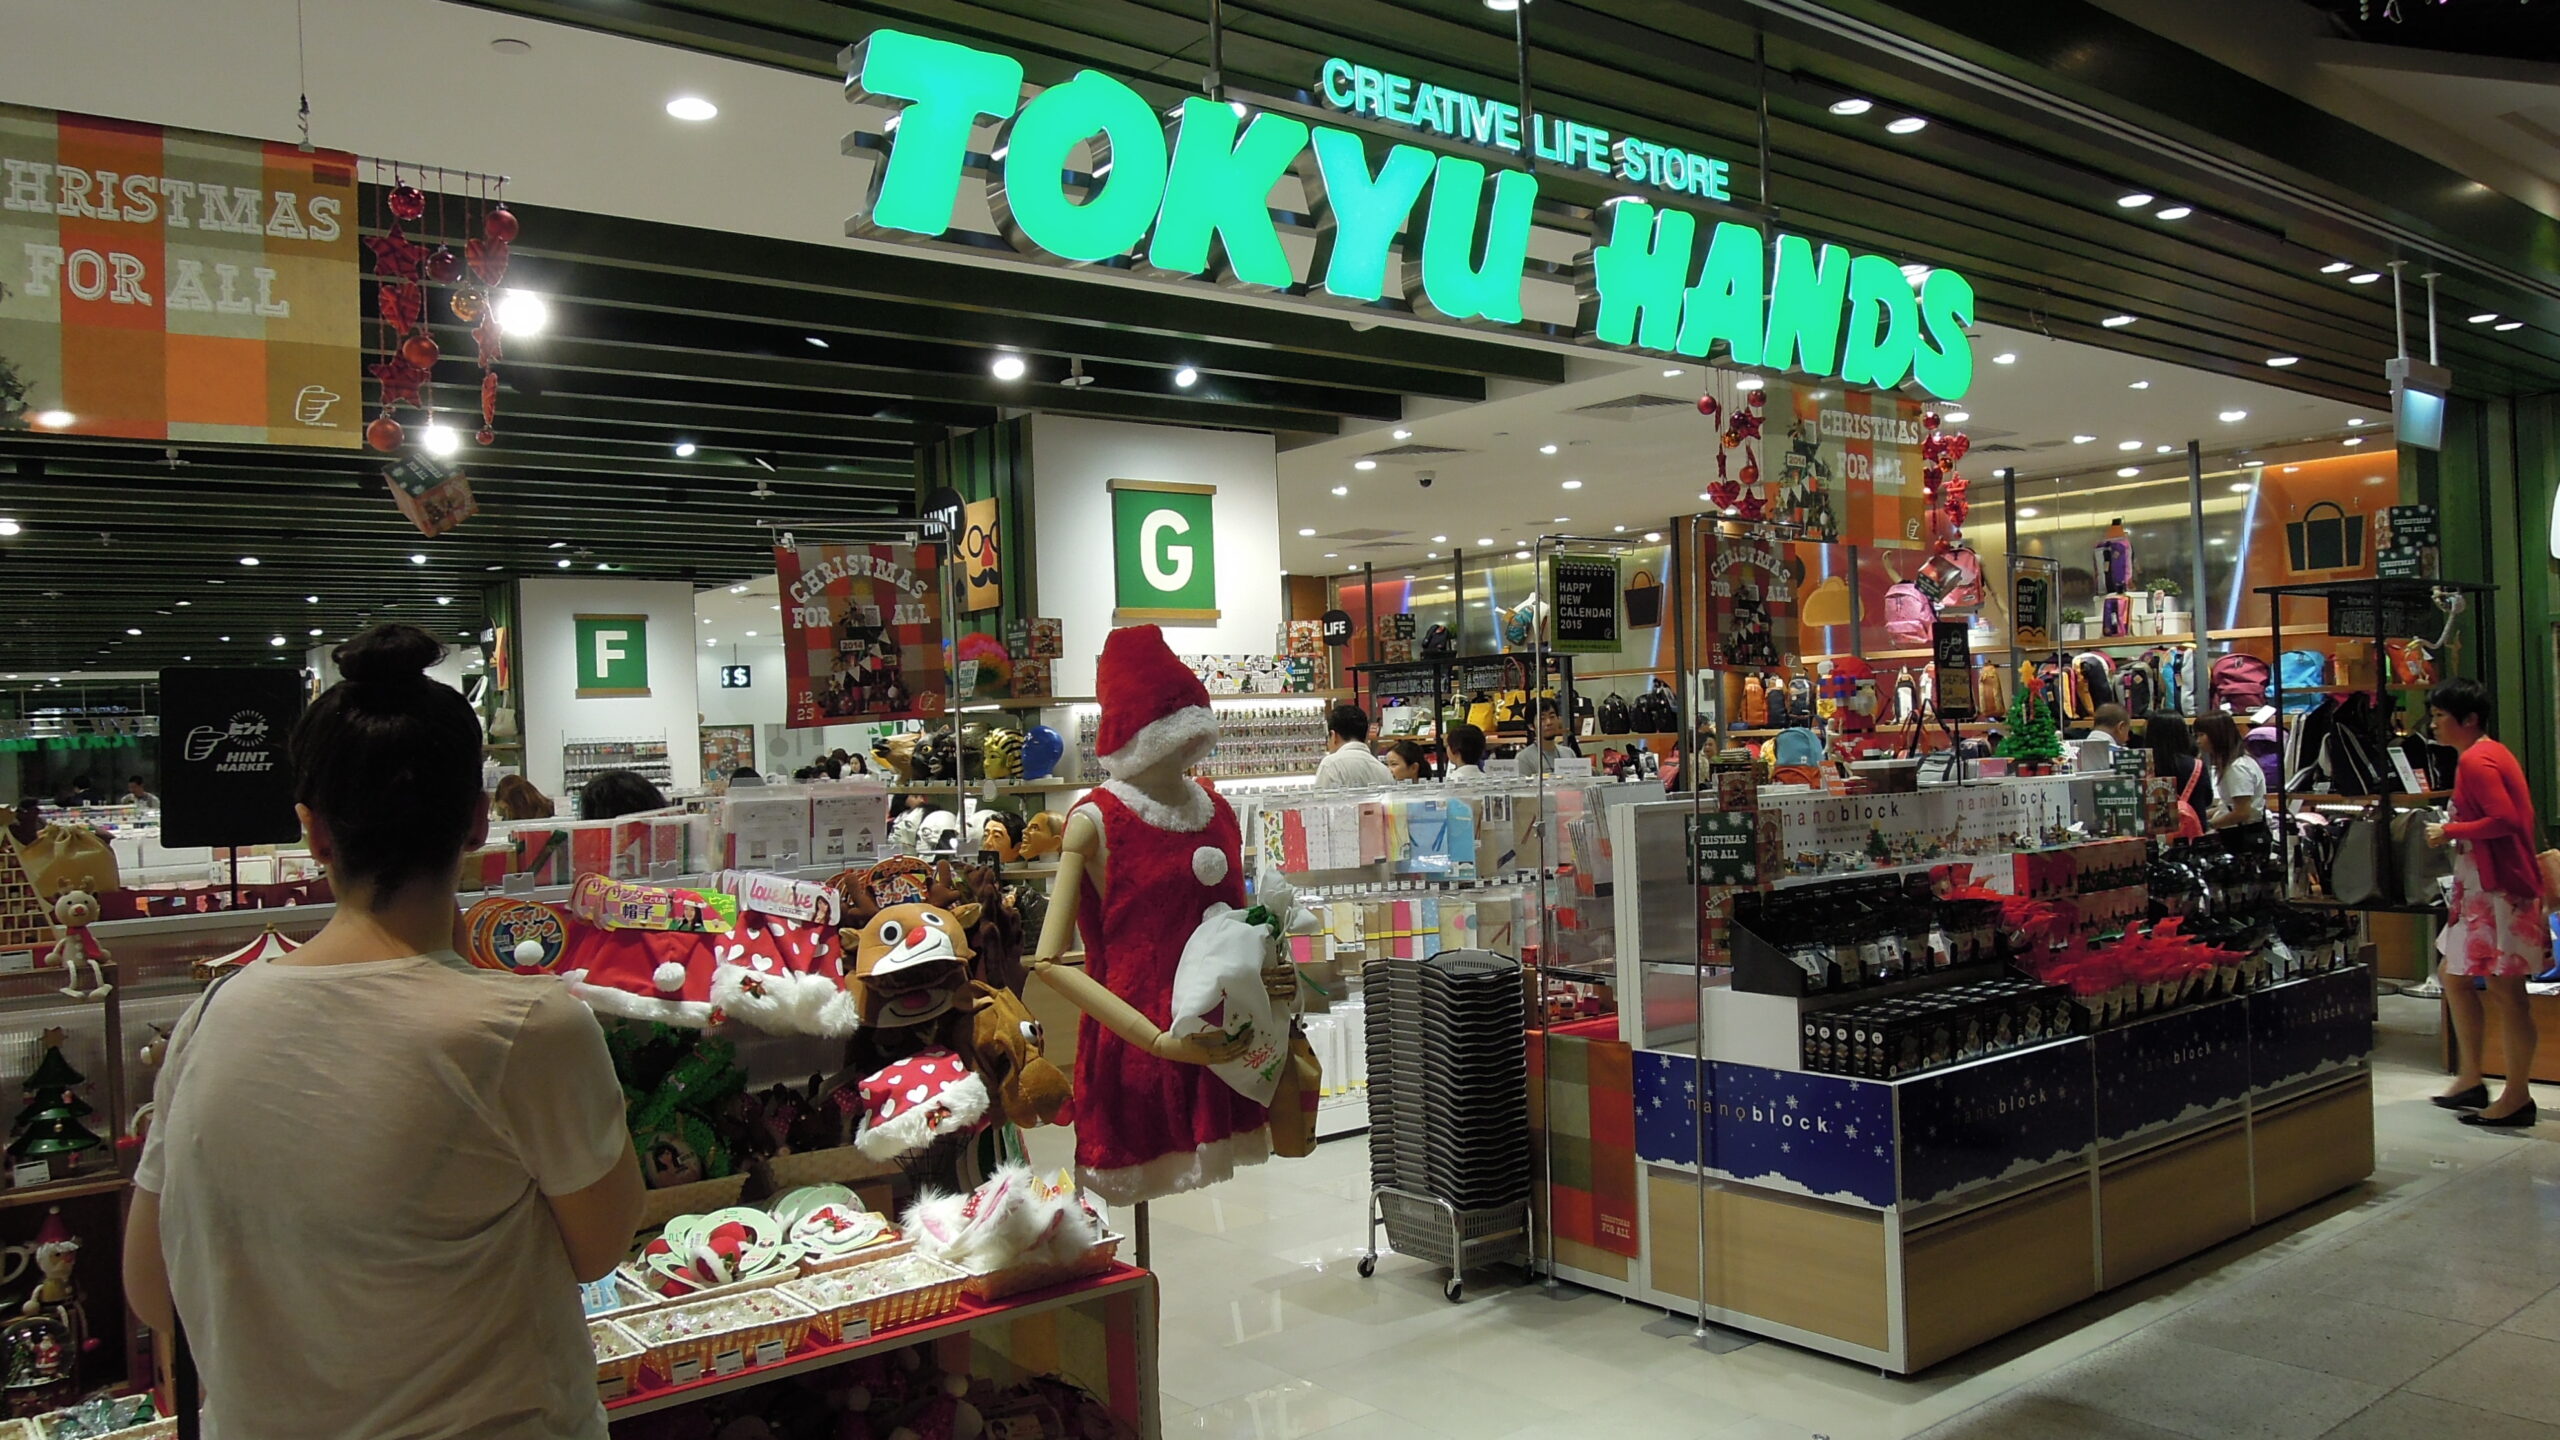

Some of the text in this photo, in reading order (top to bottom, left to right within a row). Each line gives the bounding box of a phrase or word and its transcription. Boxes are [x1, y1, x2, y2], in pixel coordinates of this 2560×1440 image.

[1322, 58, 1729, 201] CREATIVE LIFE STORE
[861, 29, 1974, 399] TOKYU HANDS
[24, 244, 290, 318] FOR ALL
[1820, 409, 1919, 445] CHRISTMAS
[1837, 451, 1906, 484] FOR ALL
[924, 505, 958, 536] HINT
[1140, 509, 1193, 592] G
[1710, 546, 1791, 583] CHRISTMAS
[789, 554, 928, 604] CHRISTMAS
[1559, 583, 1592, 594] HAPPY
[1559, 595, 1581, 605] NEW
[1711, 581, 1792, 602] FOR ALL
[792, 604, 931, 628] FOR ALL
[1560, 607, 1612, 619] CALENDAR
[1324, 621, 1346, 635] LIFE
[1560, 620, 1583, 630] 2015
[595, 630, 627, 678] F
[734, 667, 747, 686] $
[798, 691, 813, 704] 12
[797, 708, 815, 720] 25
[229, 723, 269, 735] ヒント
[226, 752, 269, 762] HINT
[216, 763, 273, 772] MARKET
[1957, 788, 2047, 811] nanoblock
[1784, 802, 1899, 828] nanoblock
[1701, 849, 1739, 859] FOR ALL
[610, 885, 644, 901] サンタ
[501, 908, 551, 925] スマイル
[622, 903, 655, 921] 帽子
[510, 920, 557, 939] サンタ
[1687, 1099, 1829, 1133] nanoblock
